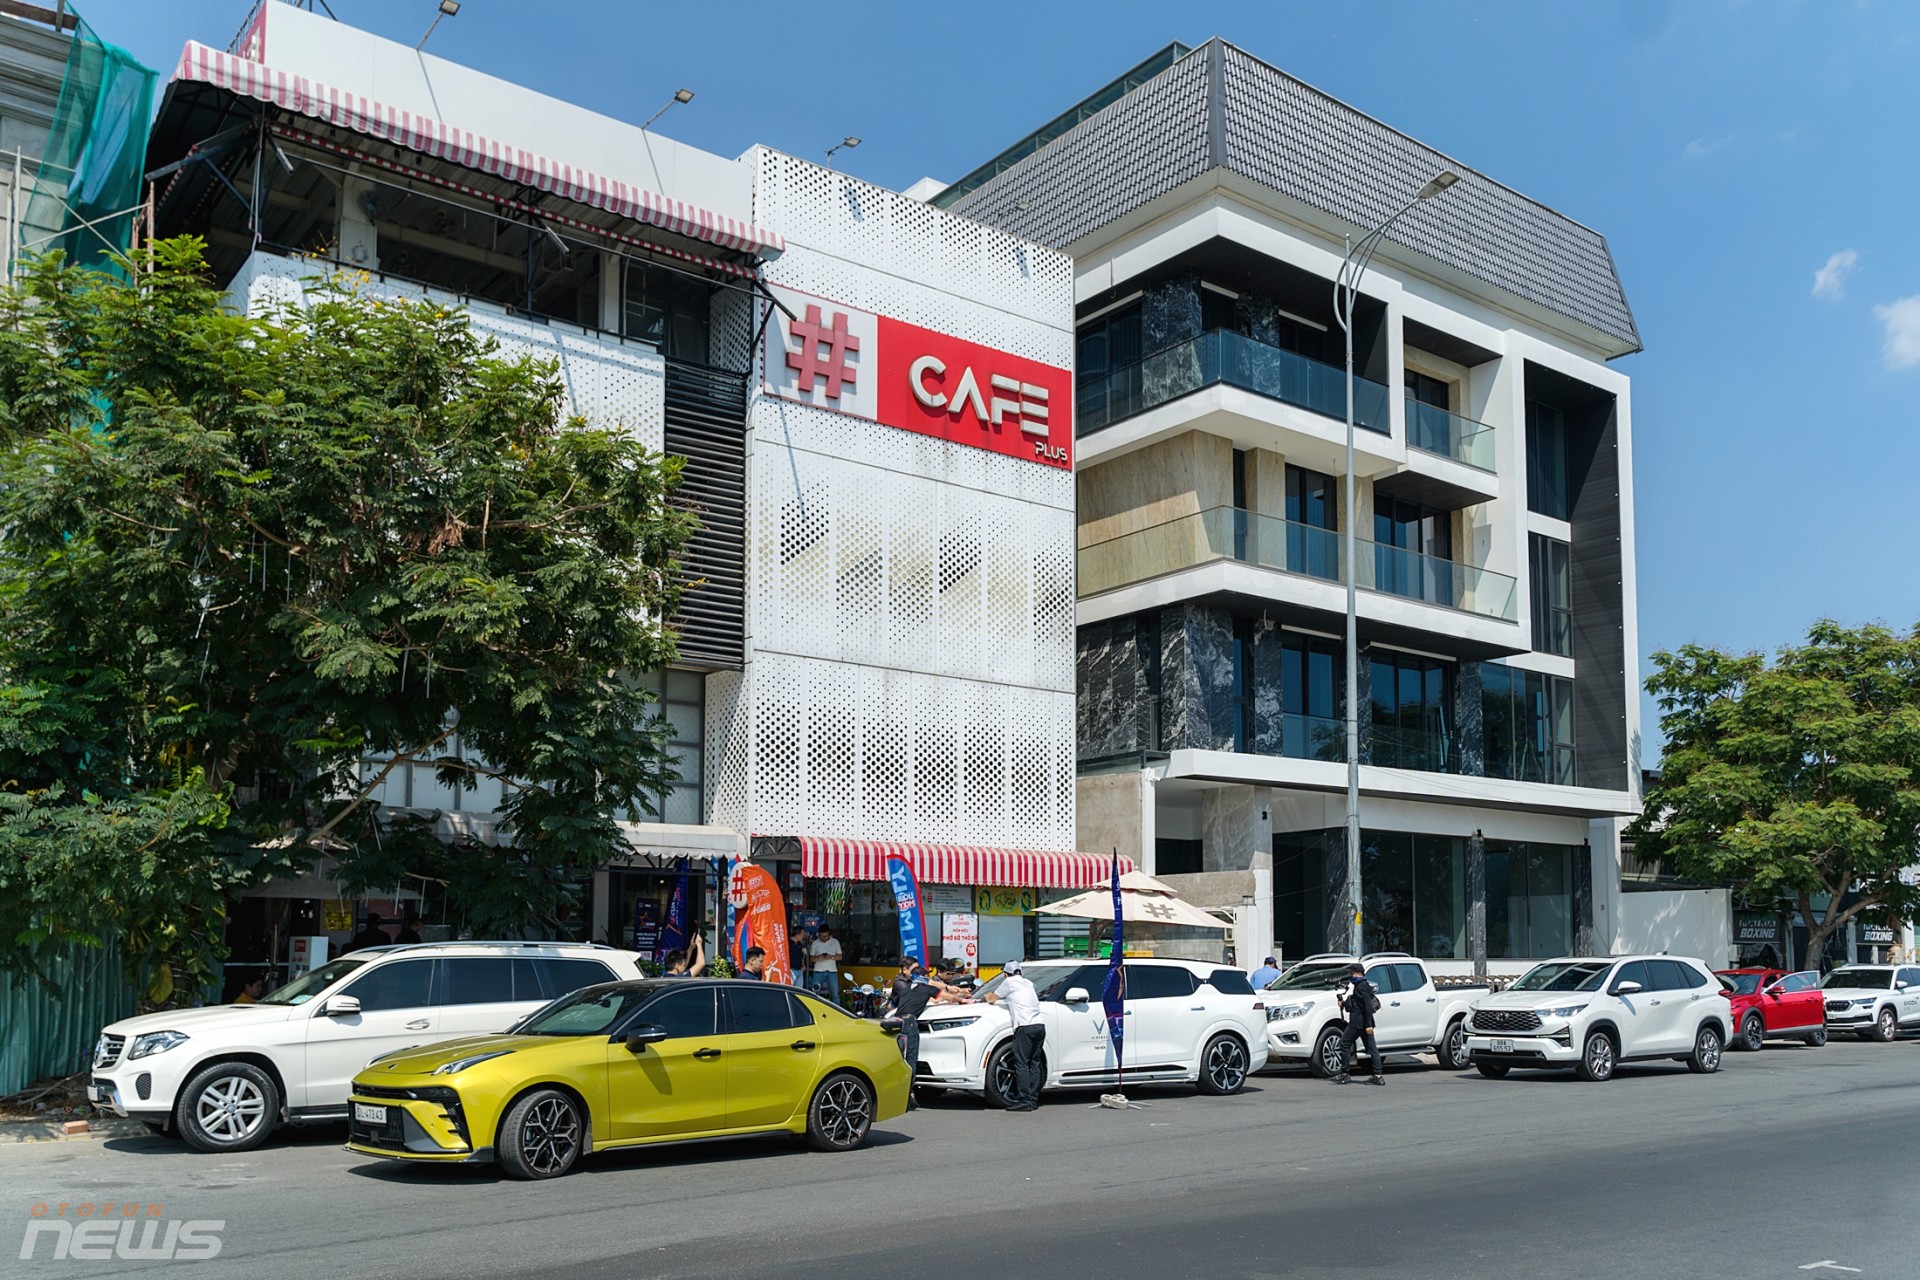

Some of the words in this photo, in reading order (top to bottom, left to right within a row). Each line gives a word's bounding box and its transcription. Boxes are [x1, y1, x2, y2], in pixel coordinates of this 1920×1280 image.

[909, 355, 1049, 437] CAFE
[1035, 441, 1068, 462] PLUS
[1739, 928, 1776, 939] BOXING
[1864, 931, 1894, 942] BOXING
